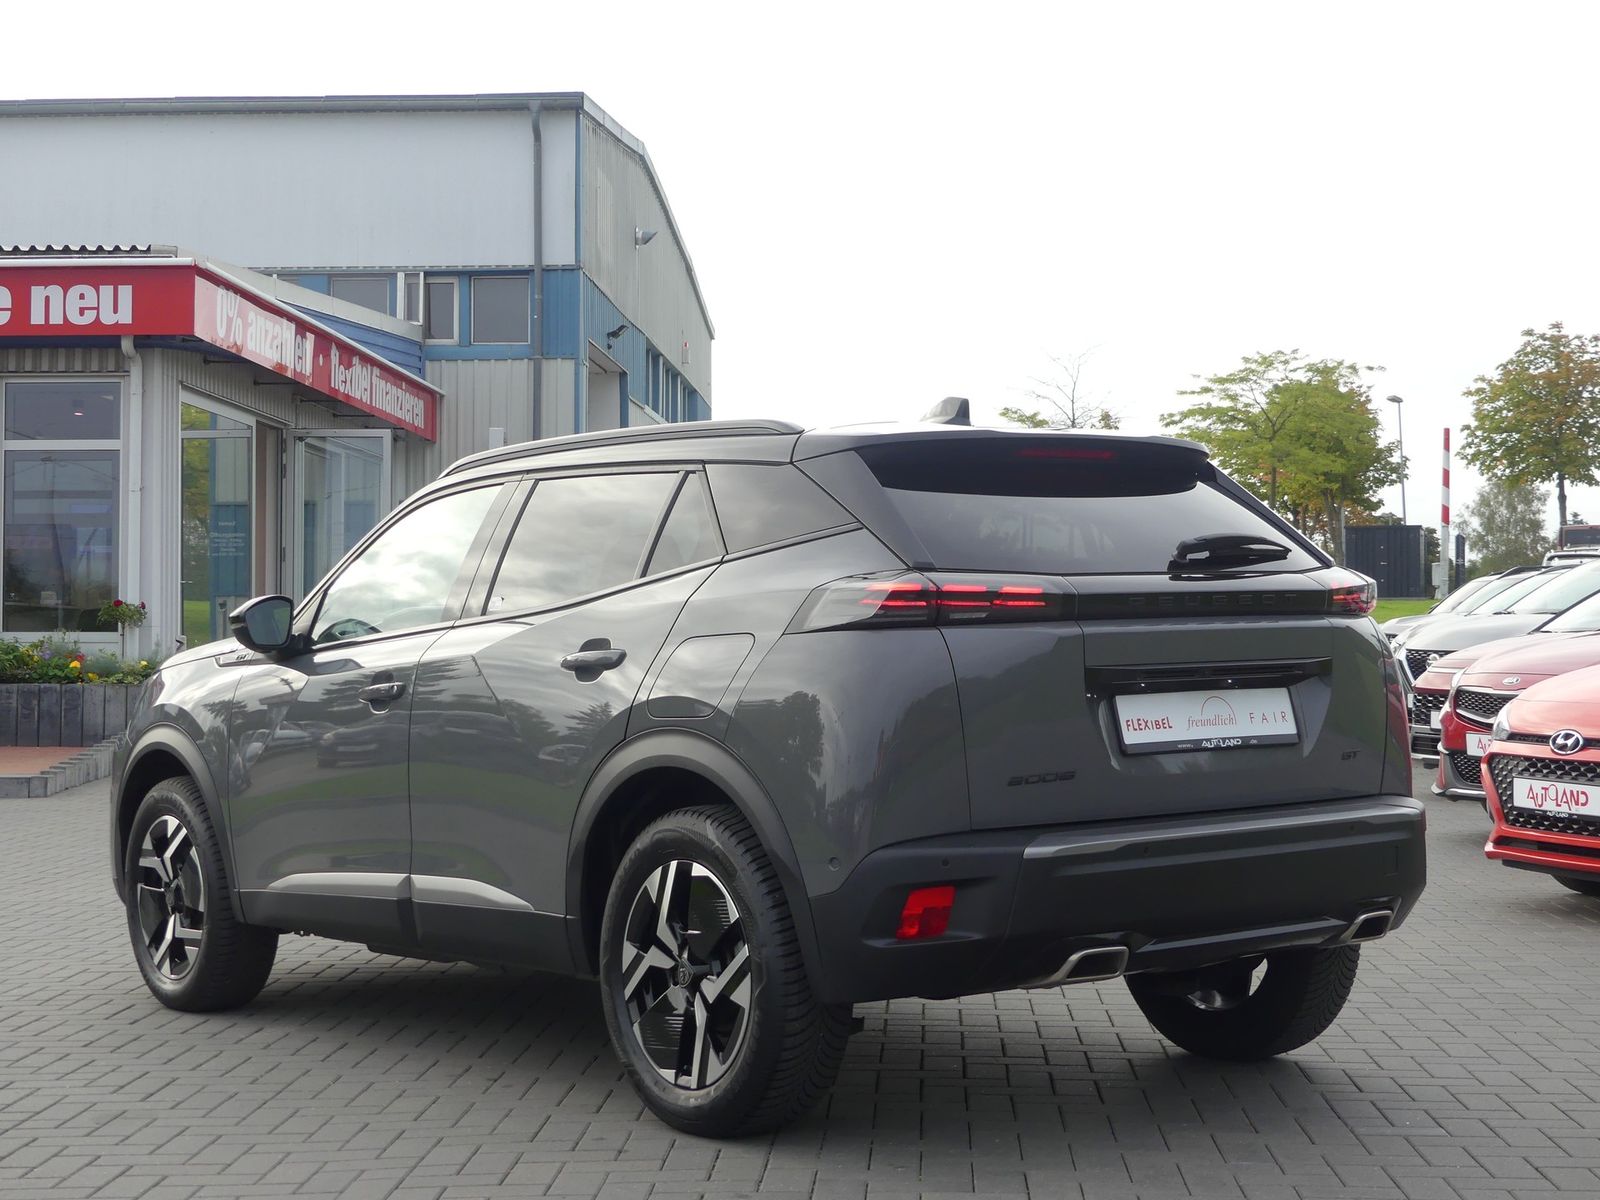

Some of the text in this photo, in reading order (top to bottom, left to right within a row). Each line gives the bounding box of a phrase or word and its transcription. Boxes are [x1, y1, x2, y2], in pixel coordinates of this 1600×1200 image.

[30, 284, 133, 326] neu
[216, 285, 243, 346] 0%
[331, 342, 371, 403] flexibel
[372, 370, 425, 429] finanzieren
[1125, 716, 1173, 732] FLEXIBEL
[1186, 713, 1235, 731] freundlich
[1201, 737, 1242, 748] AUTOLAND
[1527, 784, 1589, 811] AUTOLAND
